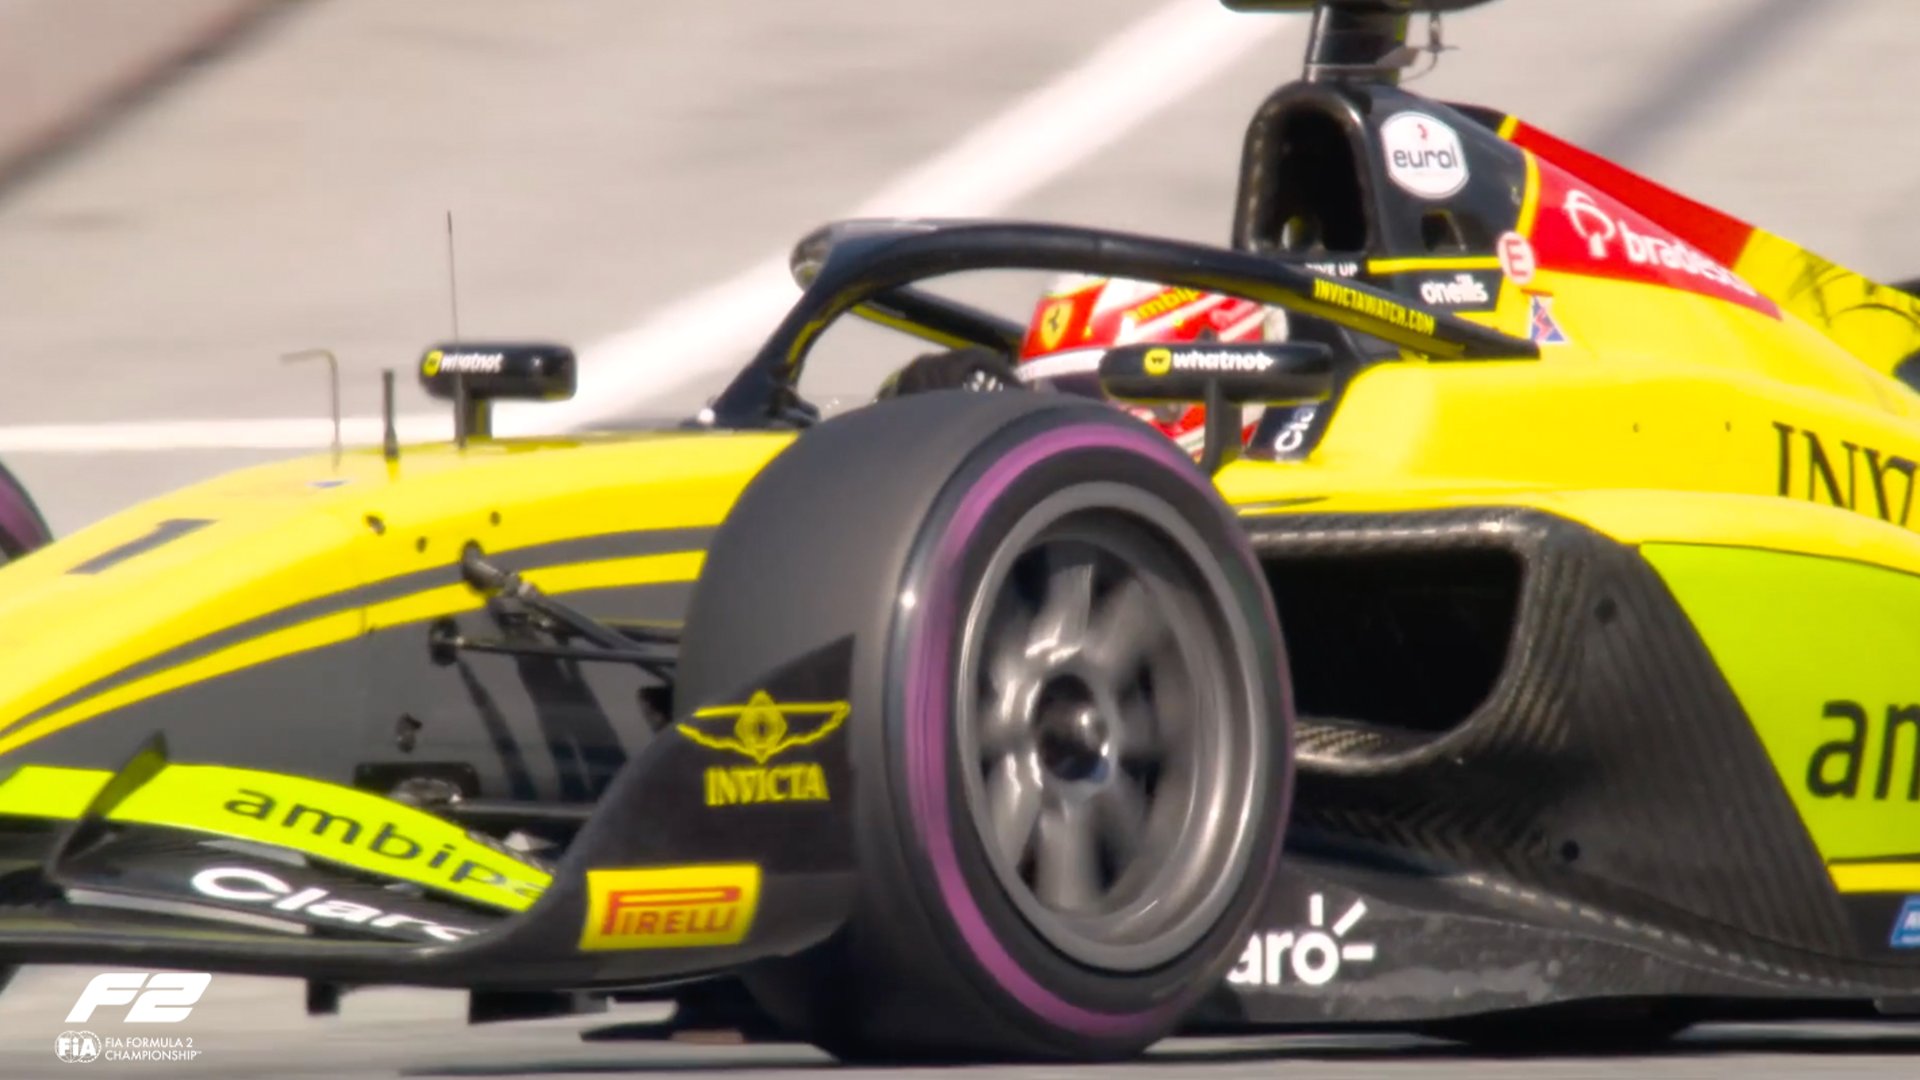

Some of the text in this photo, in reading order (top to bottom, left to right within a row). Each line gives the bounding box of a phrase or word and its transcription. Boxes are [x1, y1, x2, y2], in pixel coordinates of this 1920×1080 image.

[1393, 142, 1459, 169] eurol
[1338, 262, 1358, 277] UP
[1313, 277, 1437, 335] INVICTAWATCH.COM
[1172, 349, 1274, 371] whatnot
[66, 518, 220, 575] 1
[705, 762, 831, 806] INVICTA
[602, 886, 742, 935] PIRELLI
